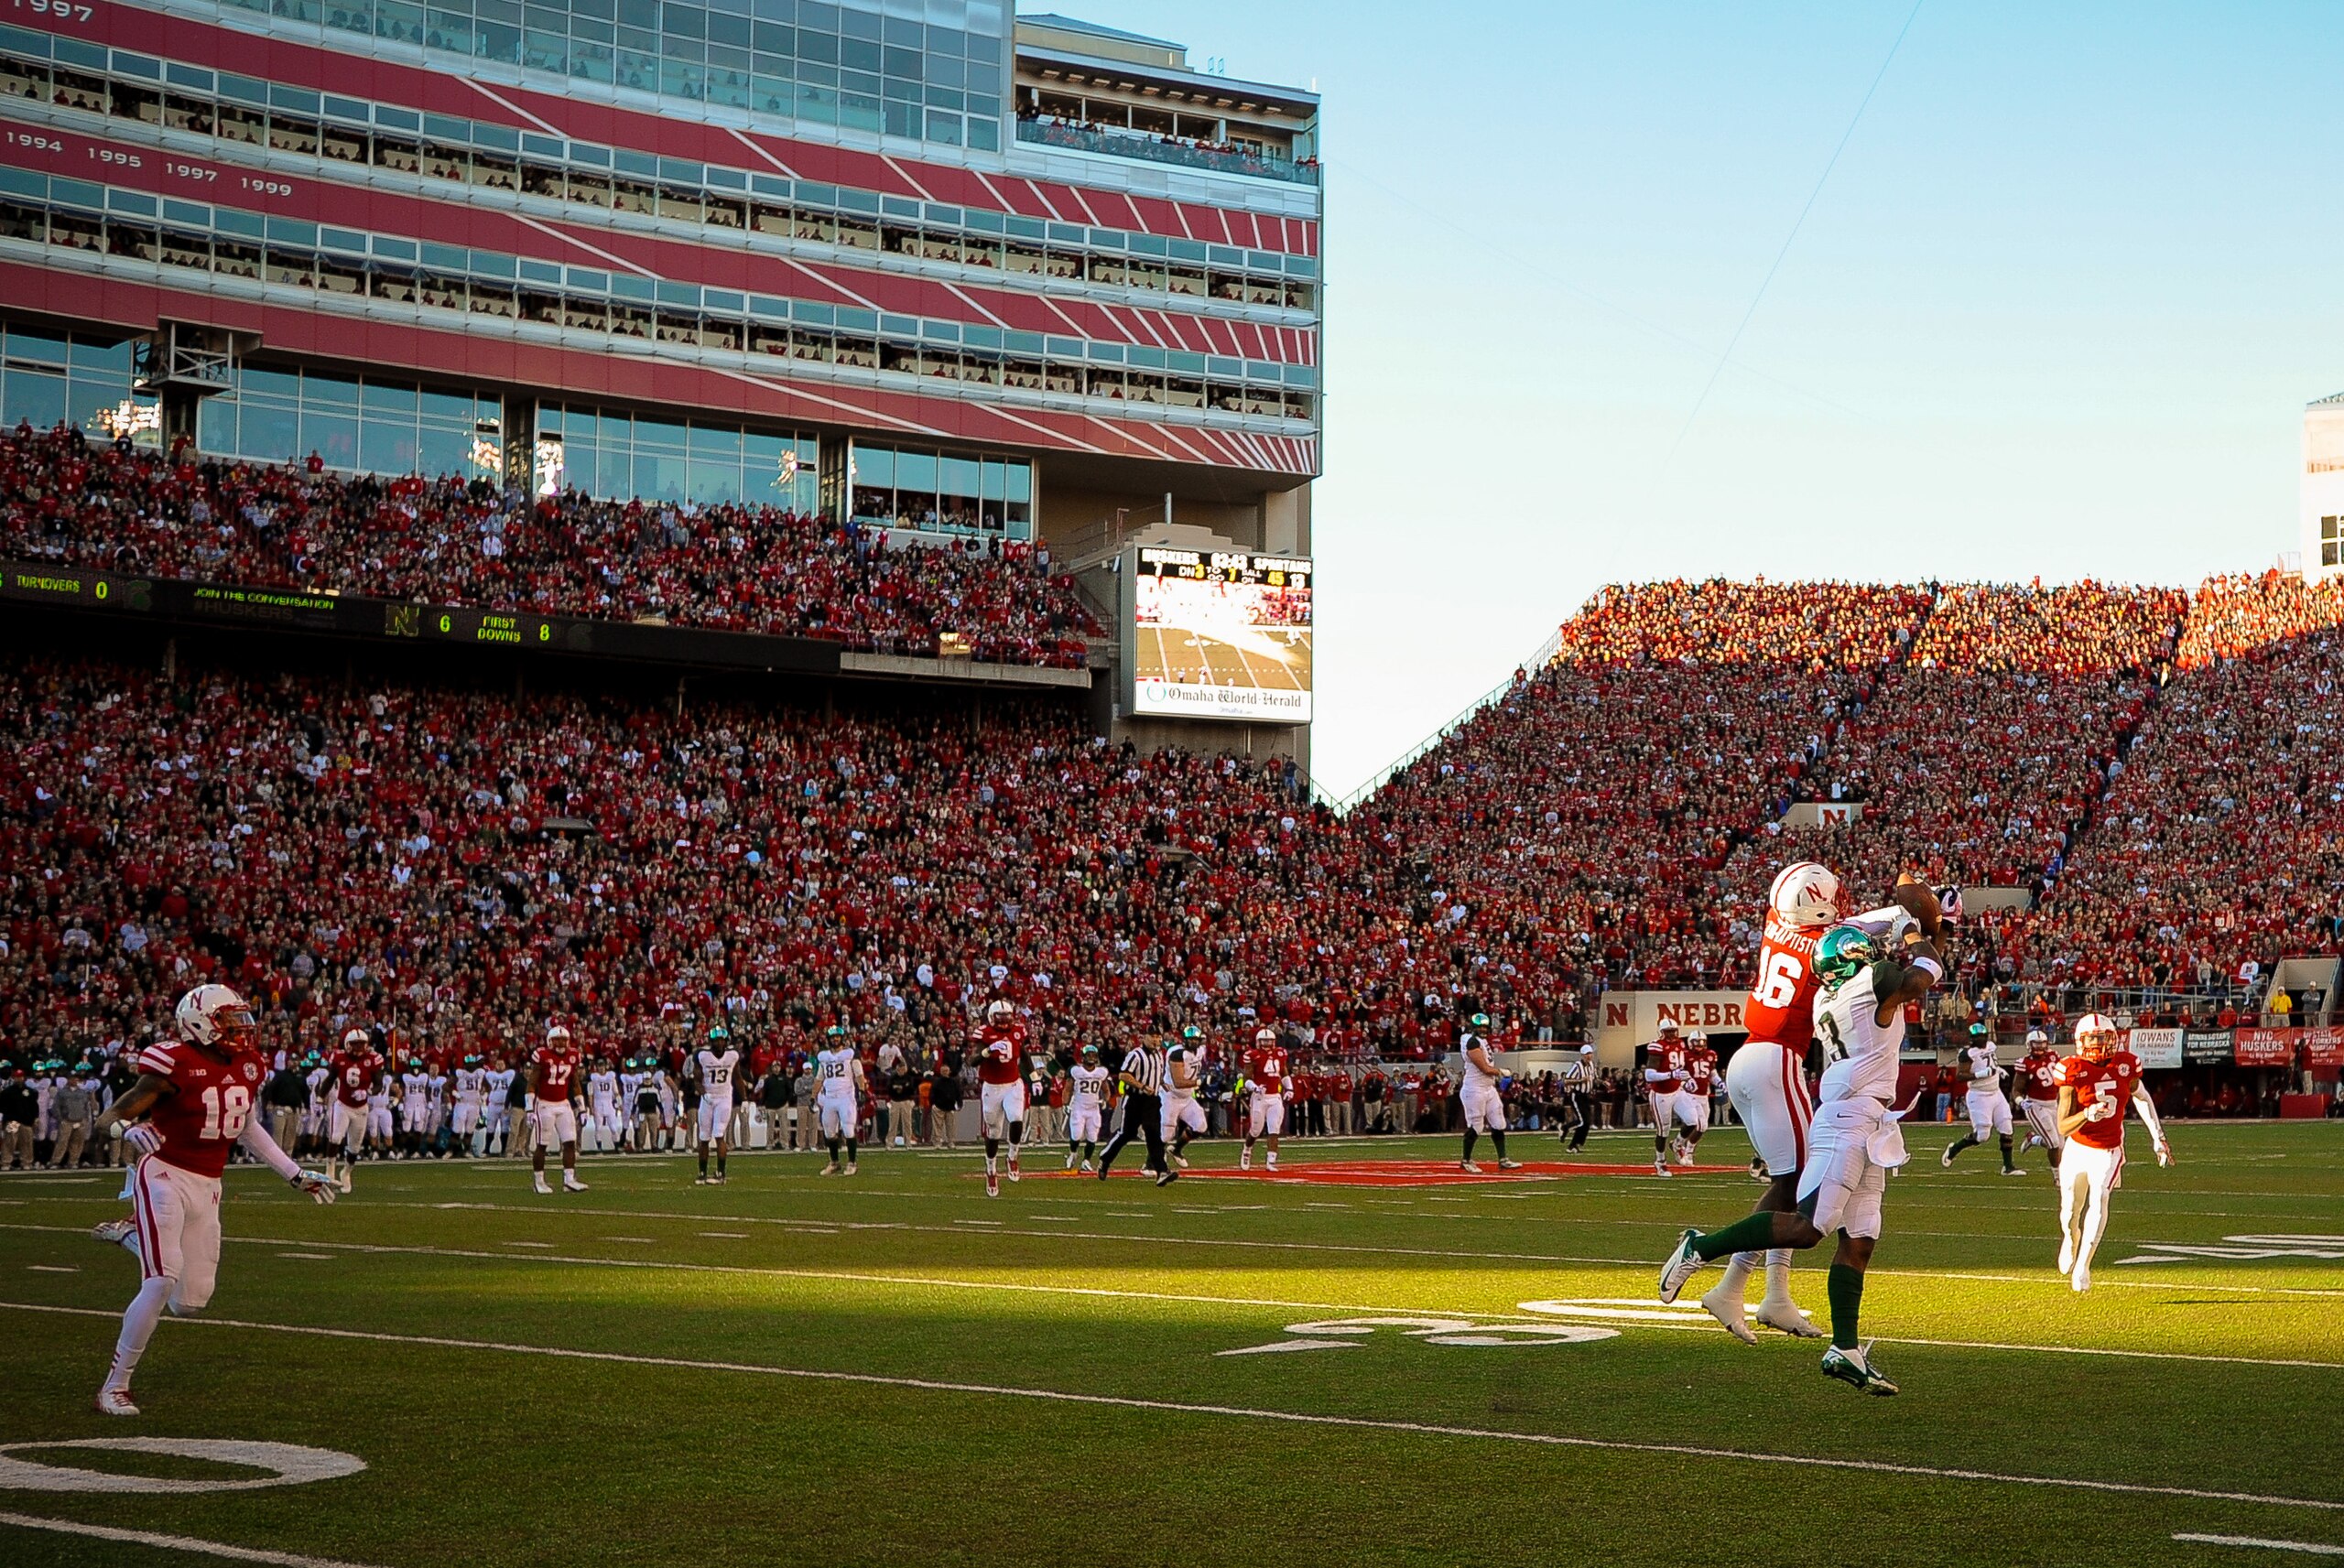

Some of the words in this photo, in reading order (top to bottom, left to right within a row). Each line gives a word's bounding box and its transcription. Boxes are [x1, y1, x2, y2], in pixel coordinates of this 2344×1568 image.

[6, 131, 63, 153] 1994
[88, 146, 142, 168] 1995
[166, 162, 218, 183] 1997
[241, 177, 292, 197] 1999
[17, 574, 81, 593] TURNOVERS
[95, 580, 108, 600] 0
[1268, 571, 1285, 586] 45
[193, 588, 219, 600] JOIN
[222, 590, 245, 601] THE
[246, 592, 335, 611] CONVERSATION
[440, 614, 450, 633] 6
[482, 615, 515, 630] FIRST
[476, 627, 521, 643] DOWNS
[539, 623, 551, 642] 8
[1168, 687, 1214, 703] Omaha
[1605, 1002, 1629, 1027] N
[2136, 1032, 2176, 1043] IOWANS
[2253, 1031, 2273, 1041] NYC
[2241, 1040, 2284, 1052] HUSKERS
[346, 1066, 362, 1087] 6
[549, 1064, 570, 1087] 17
[708, 1069, 728, 1085] 13
[825, 1062, 845, 1079] 82
[1692, 1060, 1710, 1078] 15
[1079, 1080, 1101, 1094] 20
[2094, 1079, 2118, 1119] 5
[199, 1085, 248, 1140] 18
